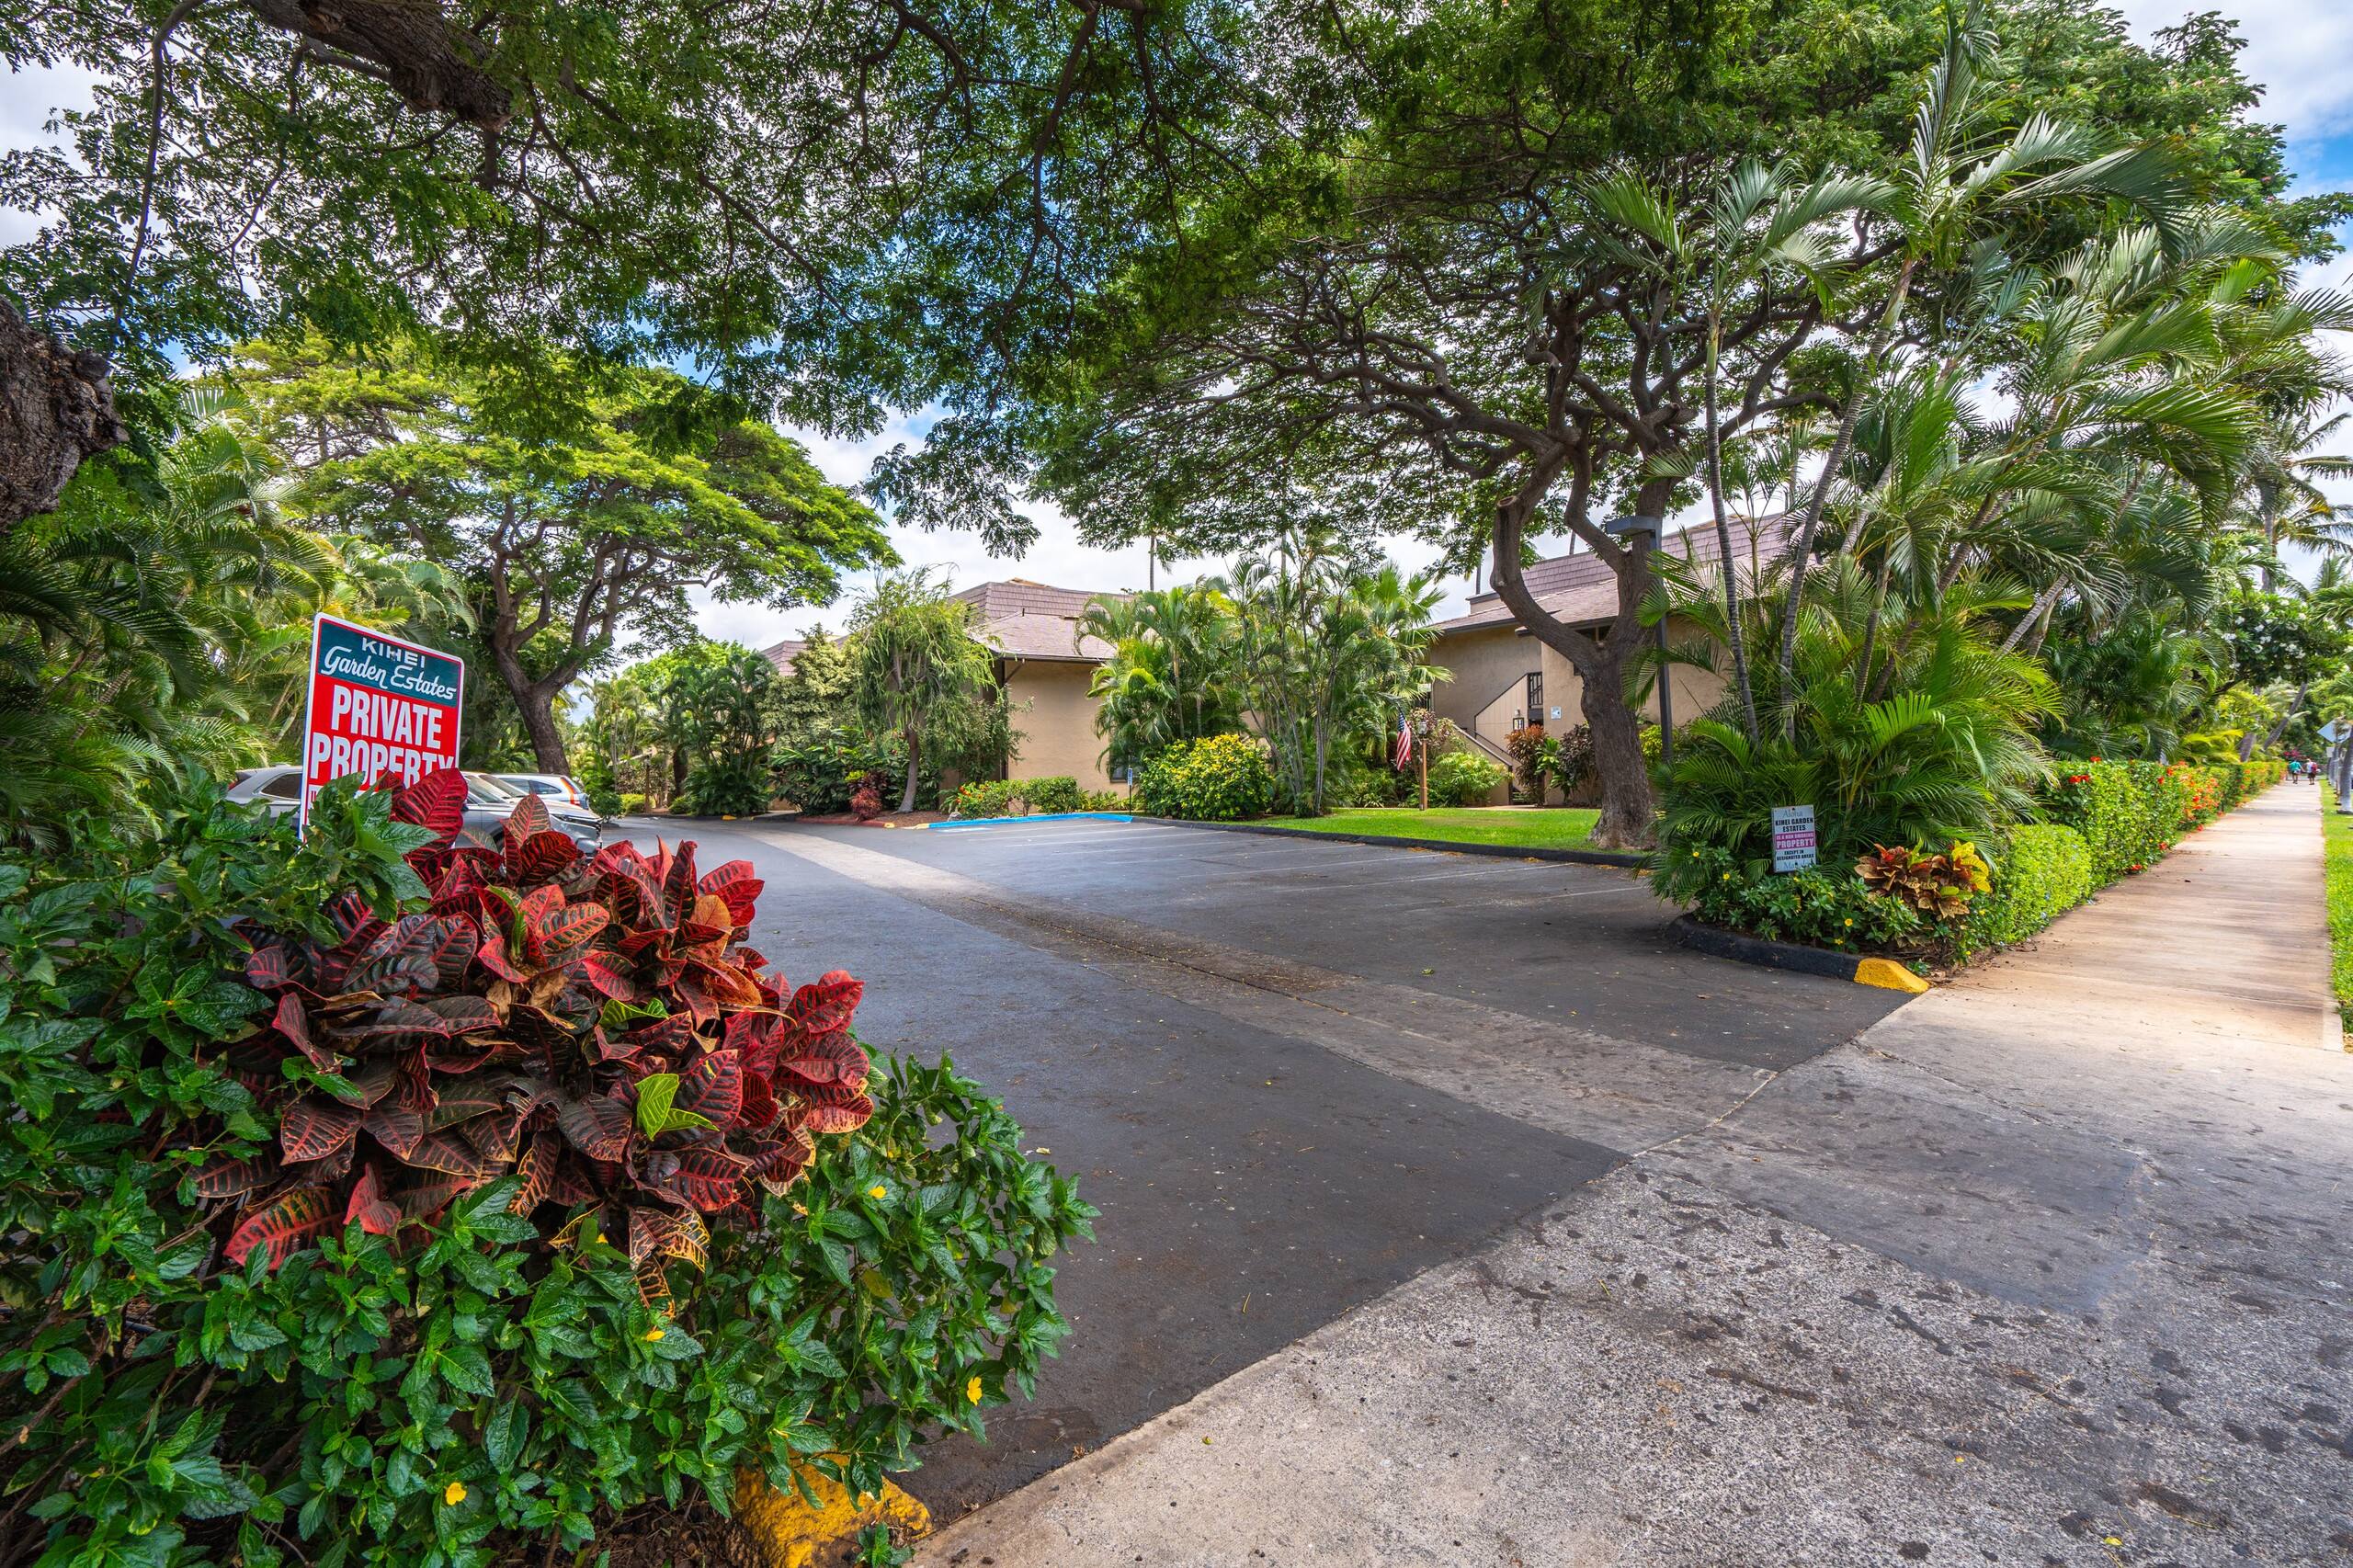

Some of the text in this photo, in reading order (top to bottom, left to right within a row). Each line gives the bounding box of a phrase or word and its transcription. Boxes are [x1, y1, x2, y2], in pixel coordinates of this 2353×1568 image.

[321, 645, 457, 699] Garden Estates
[362, 637, 426, 668] KIHEI
[331, 685, 442, 750] PRIVATE
[1777, 837, 1814, 848] PROPERTY
